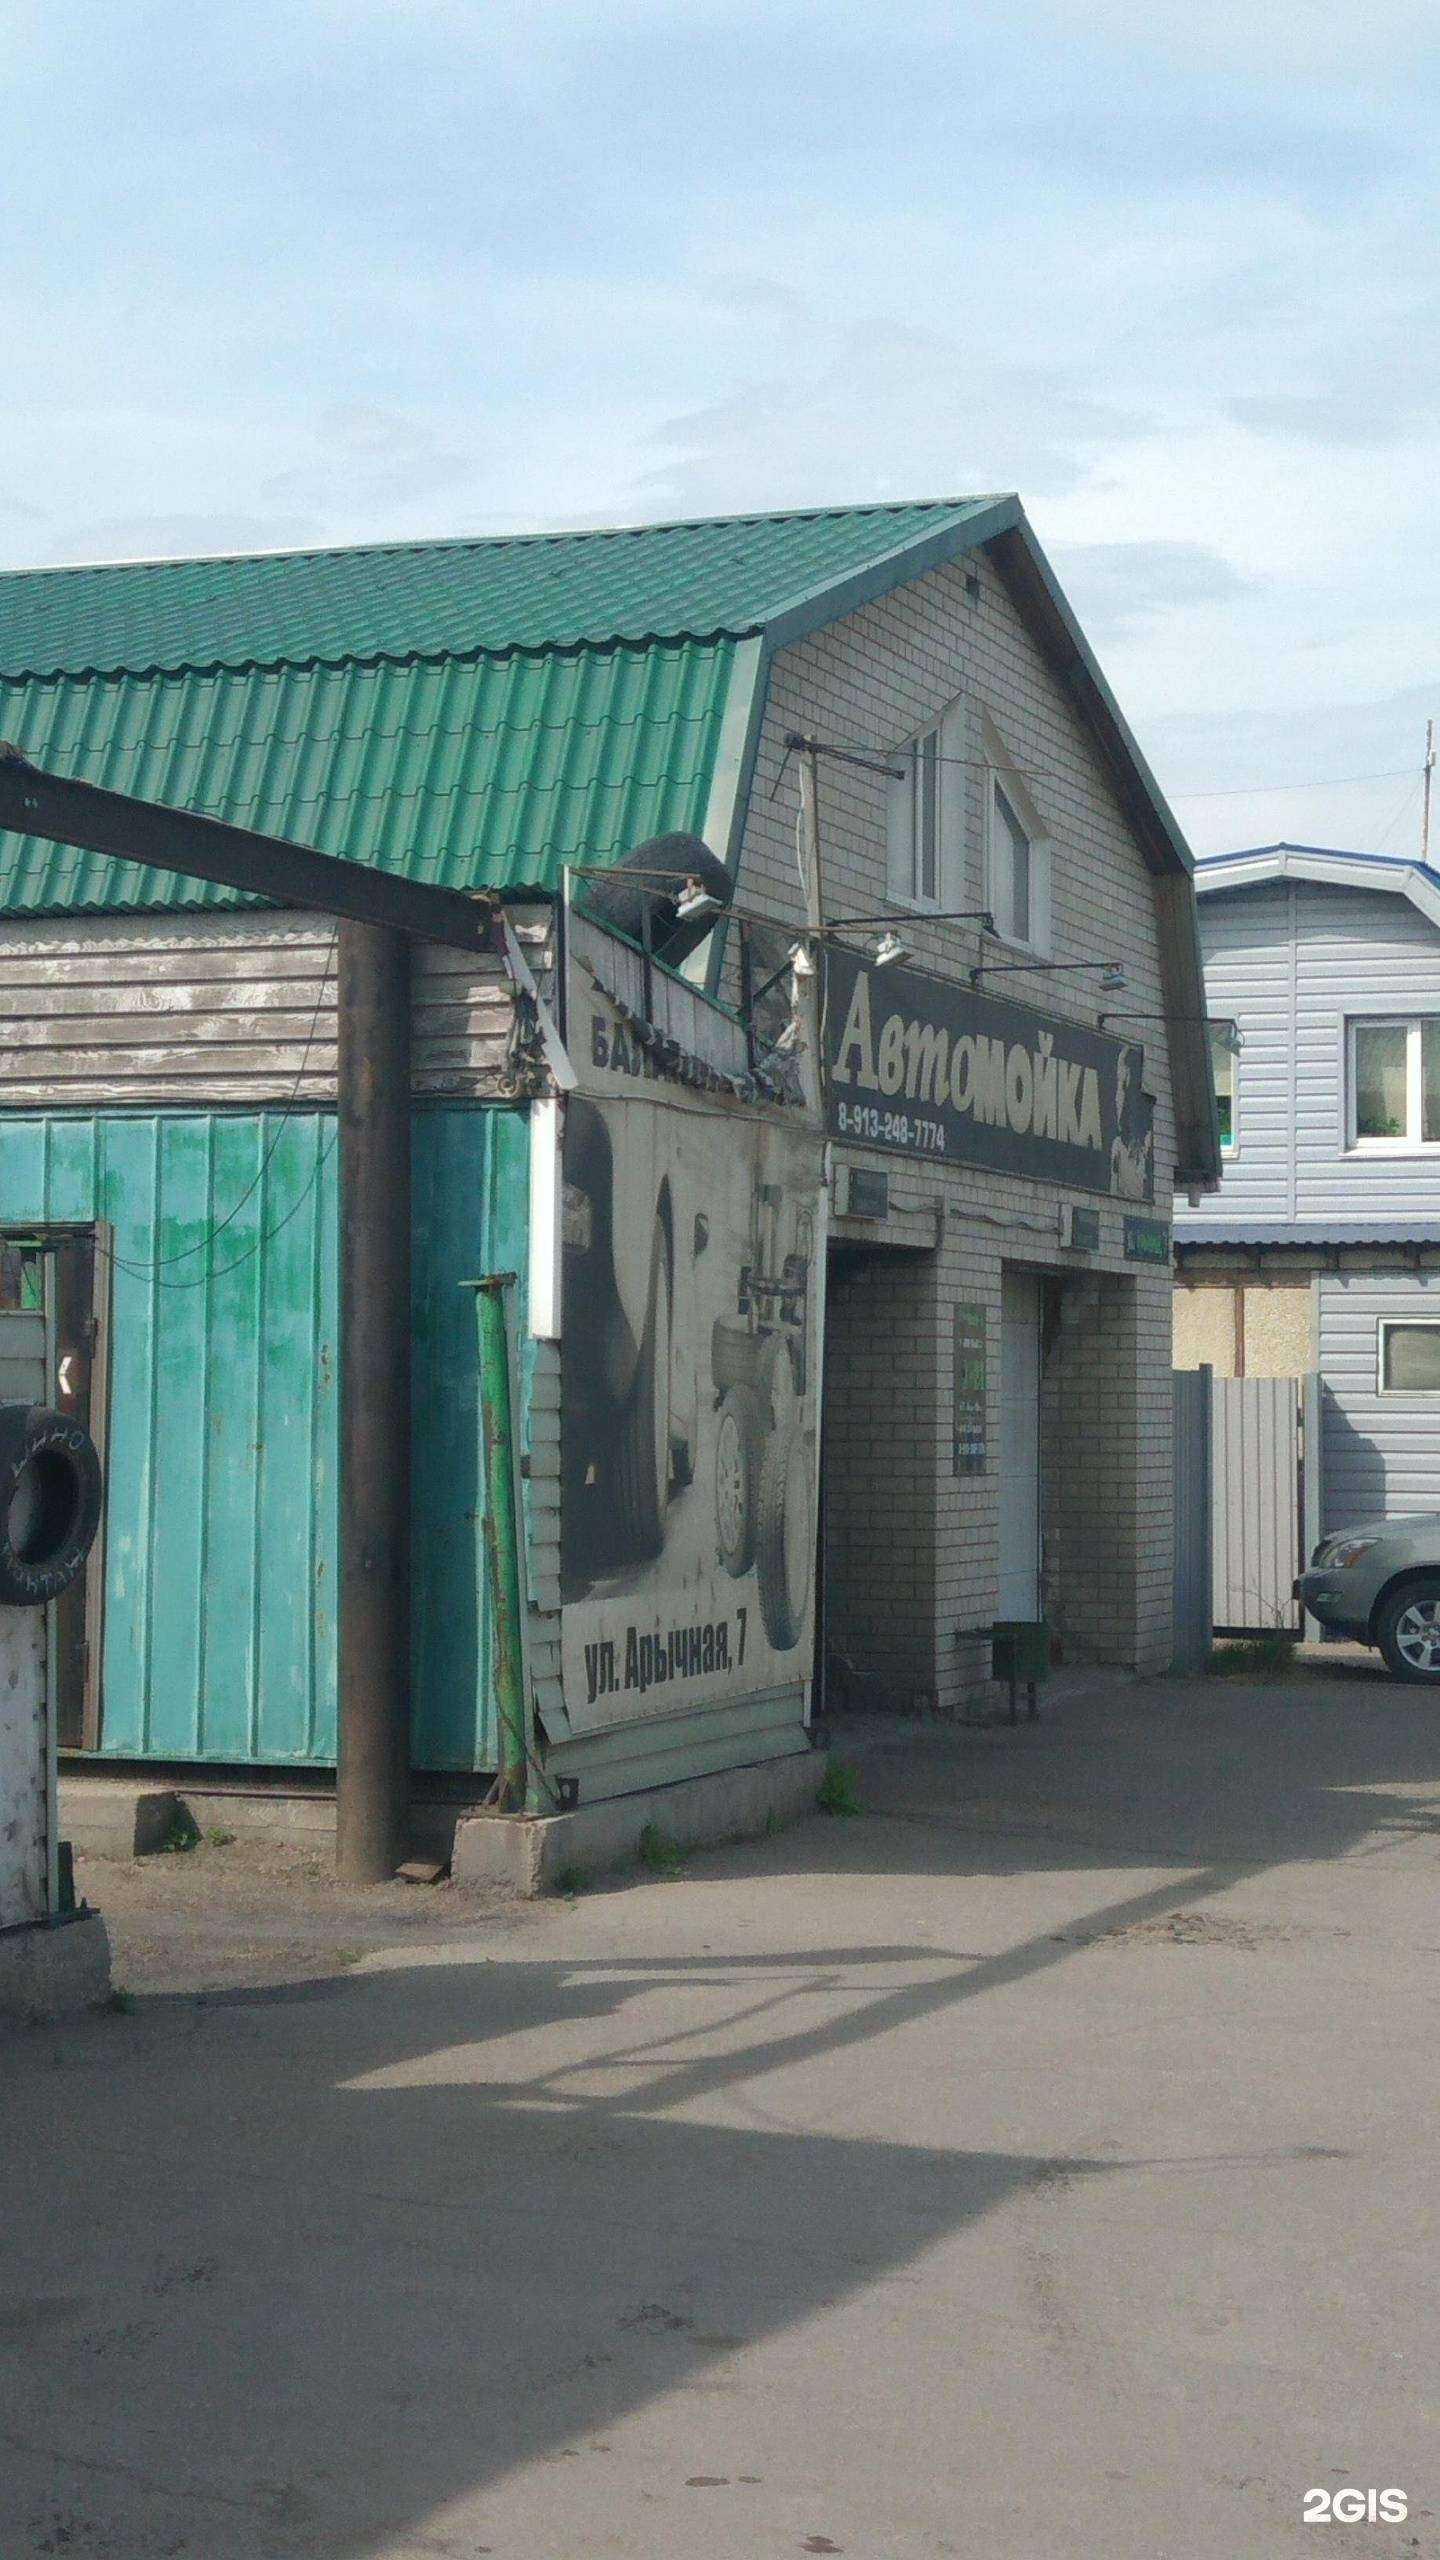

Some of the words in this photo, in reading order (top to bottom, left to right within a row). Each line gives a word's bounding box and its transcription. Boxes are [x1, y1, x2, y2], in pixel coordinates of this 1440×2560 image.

[838, 1101, 946, 1151] 8-913-248-7774
[584, 1641, 620, 1704] ул.
[625, 1621, 732, 1693] Арычная,
[737, 1608, 747, 1666] 7
